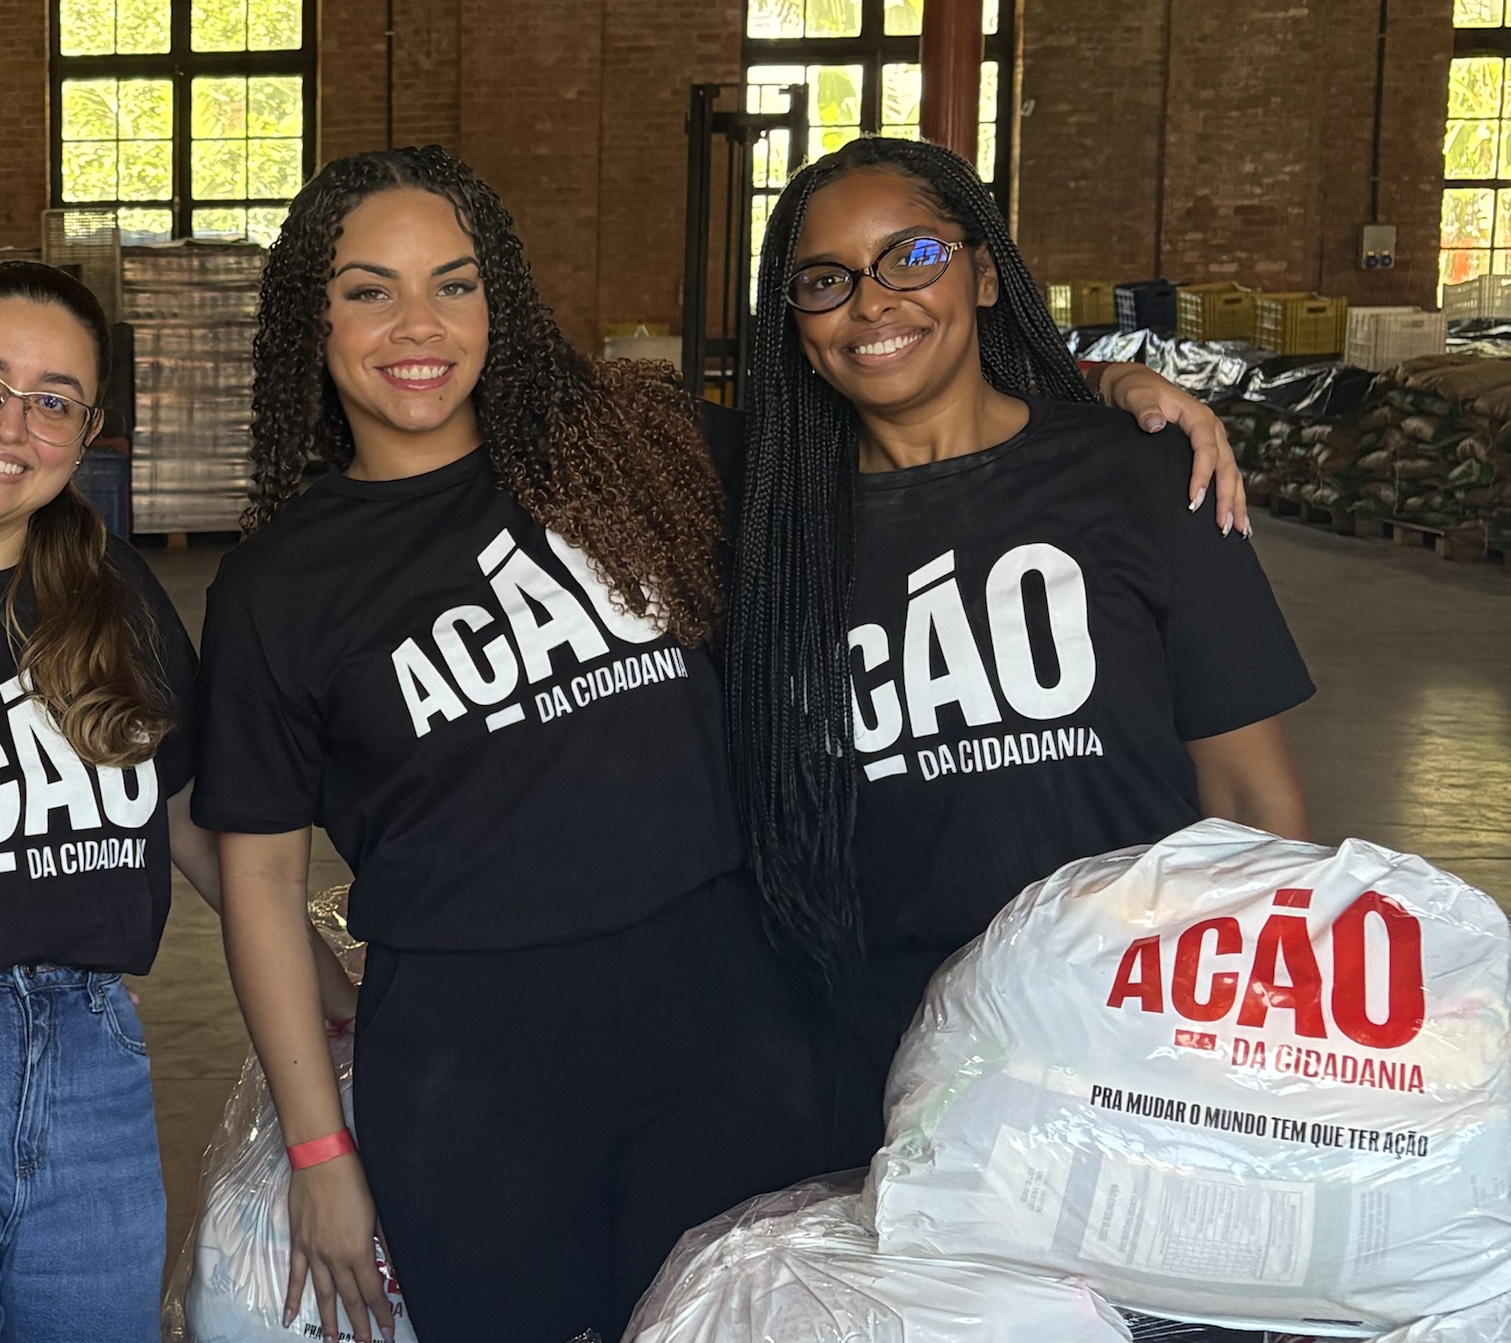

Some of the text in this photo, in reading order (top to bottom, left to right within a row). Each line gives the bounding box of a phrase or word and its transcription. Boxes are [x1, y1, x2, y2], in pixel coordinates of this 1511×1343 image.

[845, 543, 1097, 782] ÇÃO
[534, 684, 573, 724] DA
[918, 727, 1104, 781] DA CIDADANIA
[26, 846, 57, 879] DA
[1106, 888, 1426, 1050] AÇÃO
[1231, 1037, 1426, 1094] DA CIDADANIA
[1090, 1085, 1429, 1159] PRA MUDAR O MUNDO TEM QUE TER AÇÃO
